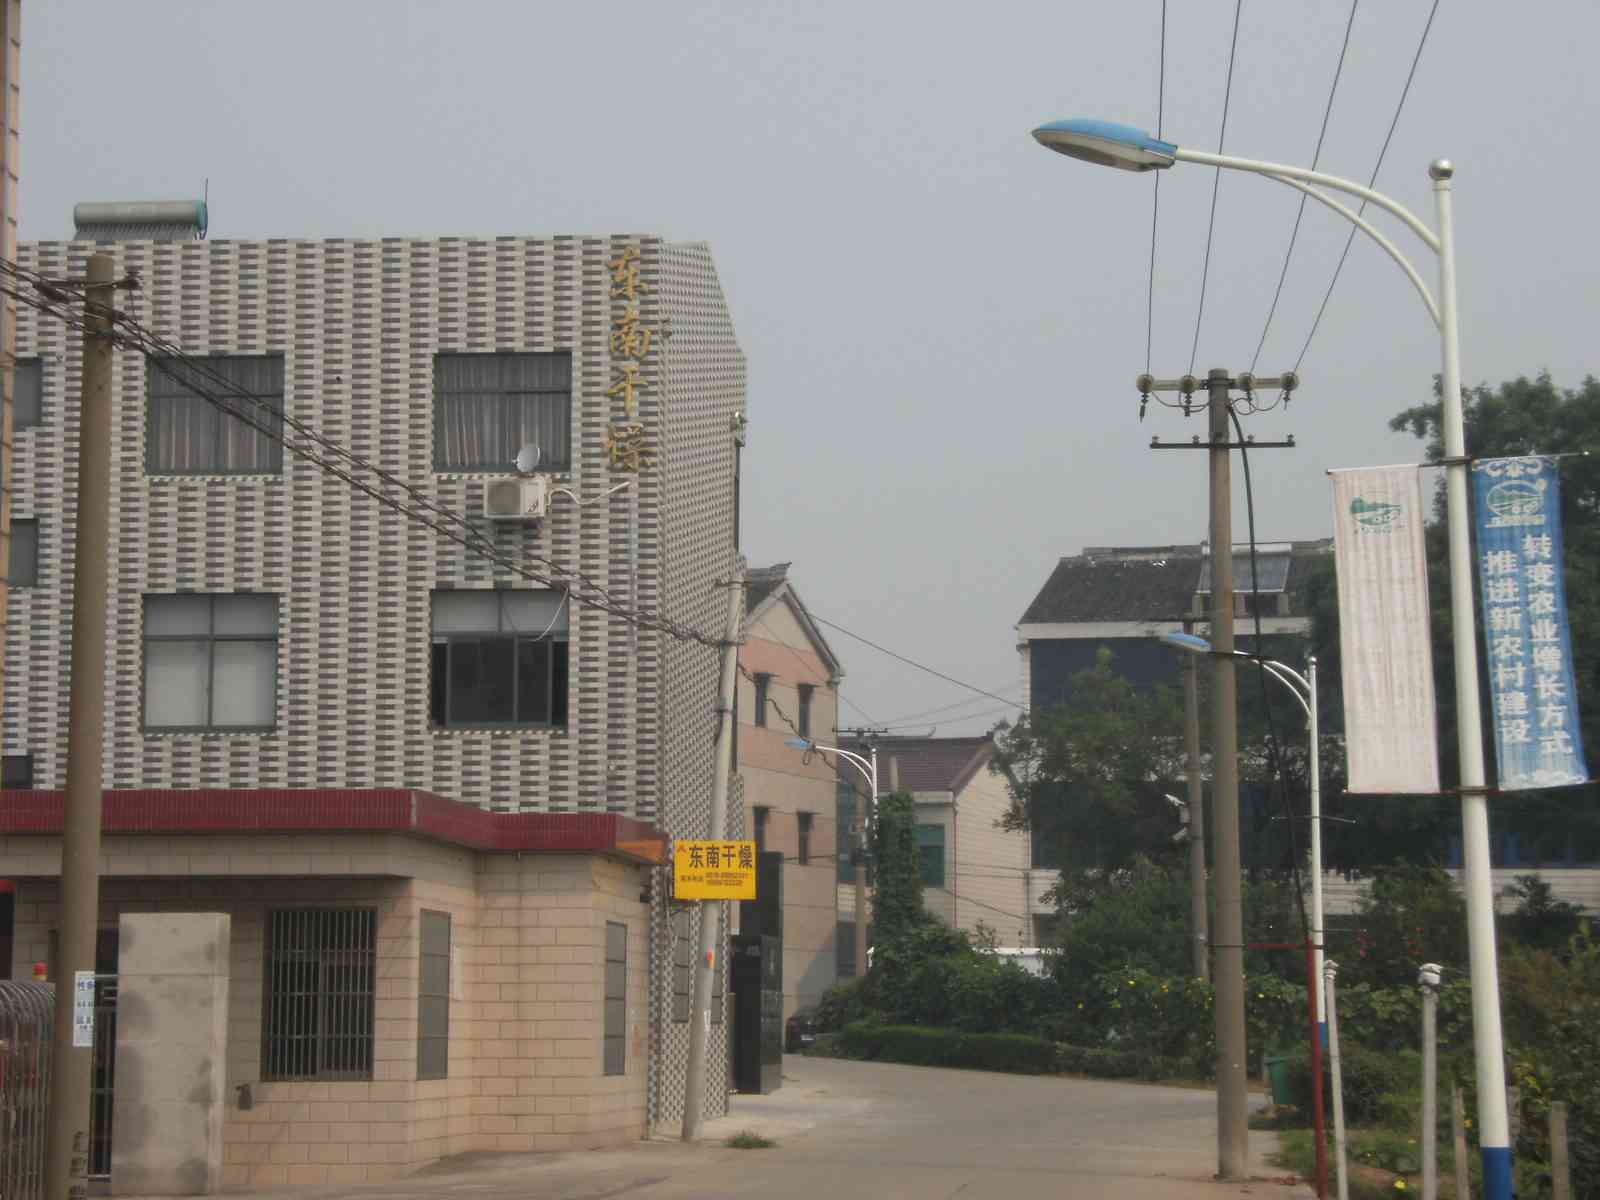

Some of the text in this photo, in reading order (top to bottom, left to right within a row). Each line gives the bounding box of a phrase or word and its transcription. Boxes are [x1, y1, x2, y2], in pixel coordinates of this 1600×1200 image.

[1484, 550, 1531, 743] 推进新农村建设
[1523, 534, 1572, 754] 转变农业增长方式
[689, 844, 752, 868] 东南干燥
